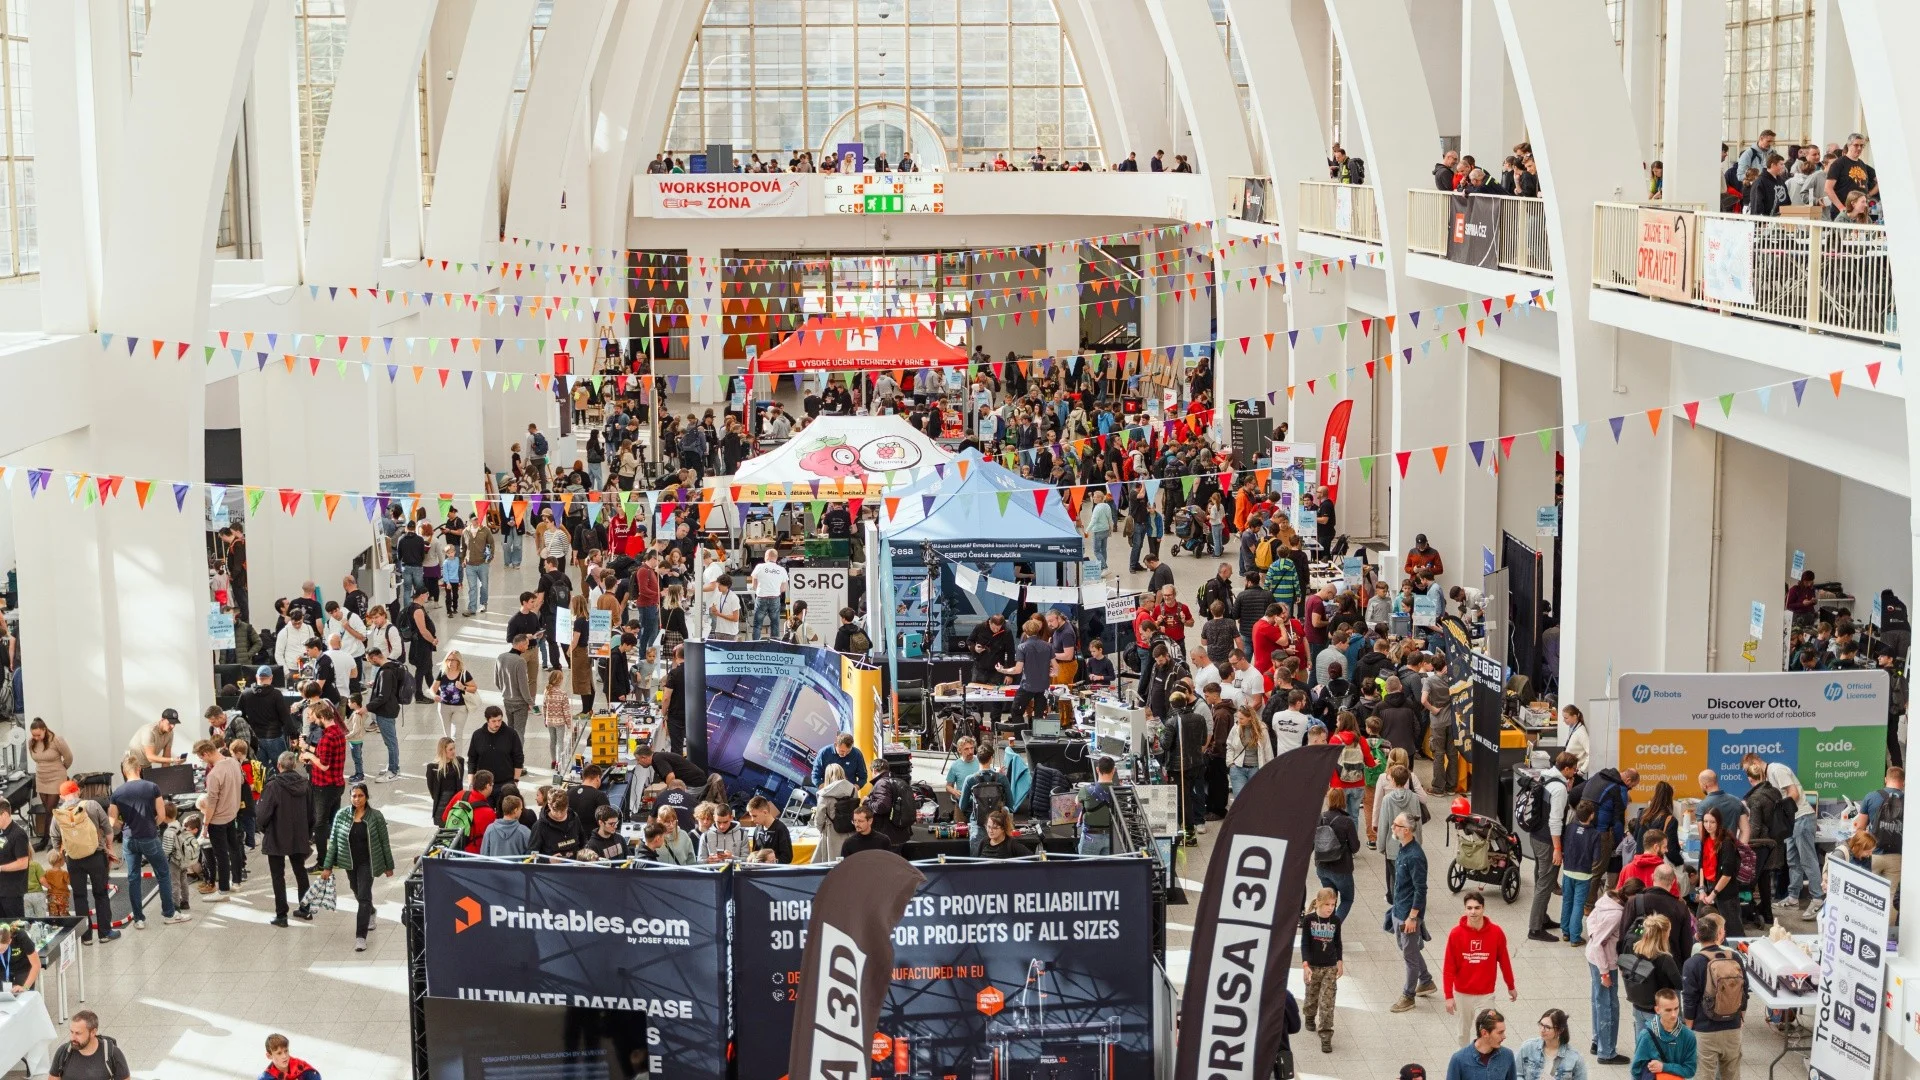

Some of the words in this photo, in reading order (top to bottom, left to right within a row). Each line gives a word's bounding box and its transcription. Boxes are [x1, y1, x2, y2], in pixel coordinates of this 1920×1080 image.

[660, 179, 781, 194] WORKSHOPOVÁ
[837, 185, 843, 193] B
[707, 195, 751, 209] ZÓNA
[839, 204, 853, 214] C,E
[1479, 221, 1487, 238] ČEZ
[801, 358, 830, 367] VYSOKÉ
[832, 357, 854, 367] UČENÍ
[856, 357, 896, 366] TECHNICKÉ
[968, 550, 989, 558] Česká
[1106, 599, 1133, 609] Vědátor
[726, 652, 746, 661] Our
[748, 653, 794, 665] technology
[726, 665, 751, 673] starts
[753, 666, 772, 675] with
[774, 667, 790, 676] You
[1633, 684, 1650, 703] hp
[1654, 690, 1682, 699] Robots
[1824, 682, 1843, 702] hp
[1846, 682, 1872, 691] Official
[1846, 691, 1877, 700] Licensee
[1707, 697, 1764, 710] Discover
[1768, 697, 1802, 710] Otto,
[1691, 712, 1709, 721] your
[1709, 711, 1730, 720] guide
[1740, 711, 1753, 719] the
[1753, 711, 1775, 719] world
[1776, 710, 1785, 718] of
[1785, 710, 1816, 718] robotics
[1635, 742, 1687, 755] create.
[1721, 742, 1785, 755] connect.
[1816, 739, 1856, 752] code.
[1635, 762, 1666, 771] Unleash
[1720, 762, 1740, 771] Build
[1833, 760, 1859, 769] coding
[1640, 773, 1670, 783] reativity
[1671, 773, 1688, 781] with
[1720, 773, 1743, 781] robot.
[1833, 770, 1868, 779] beginner
[1815, 781, 1822, 789] to
[1823, 781, 1839, 789] Pro.
[1232, 845, 1273, 912] 3D
[940, 895, 1008, 916] PROVEN
[1014, 890, 1120, 913] RELIABILITY!
[1845, 884, 1884, 909] ŽELEZNICE
[489, 904, 690, 937] Printables.com
[627, 936, 637, 945] by
[638, 936, 662, 945] JOSEF
[663, 937, 690, 946] PRUSA
[770, 929, 794, 950] 3D
[923, 923, 1007, 946] PROJECTS
[1013, 922, 1033, 942] OF
[1038, 920, 1068, 942] ALL
[1072, 919, 1120, 940] SIZES
[1842, 932, 1853, 943] 3D
[892, 966, 954, 981] NUFACTURED
[957, 966, 967, 978] IN
[970, 965, 985, 978] EU
[827, 944, 860, 1029] 3D
[574, 995, 693, 1019] DATABASE
[1838, 1004, 1852, 1021] VR
